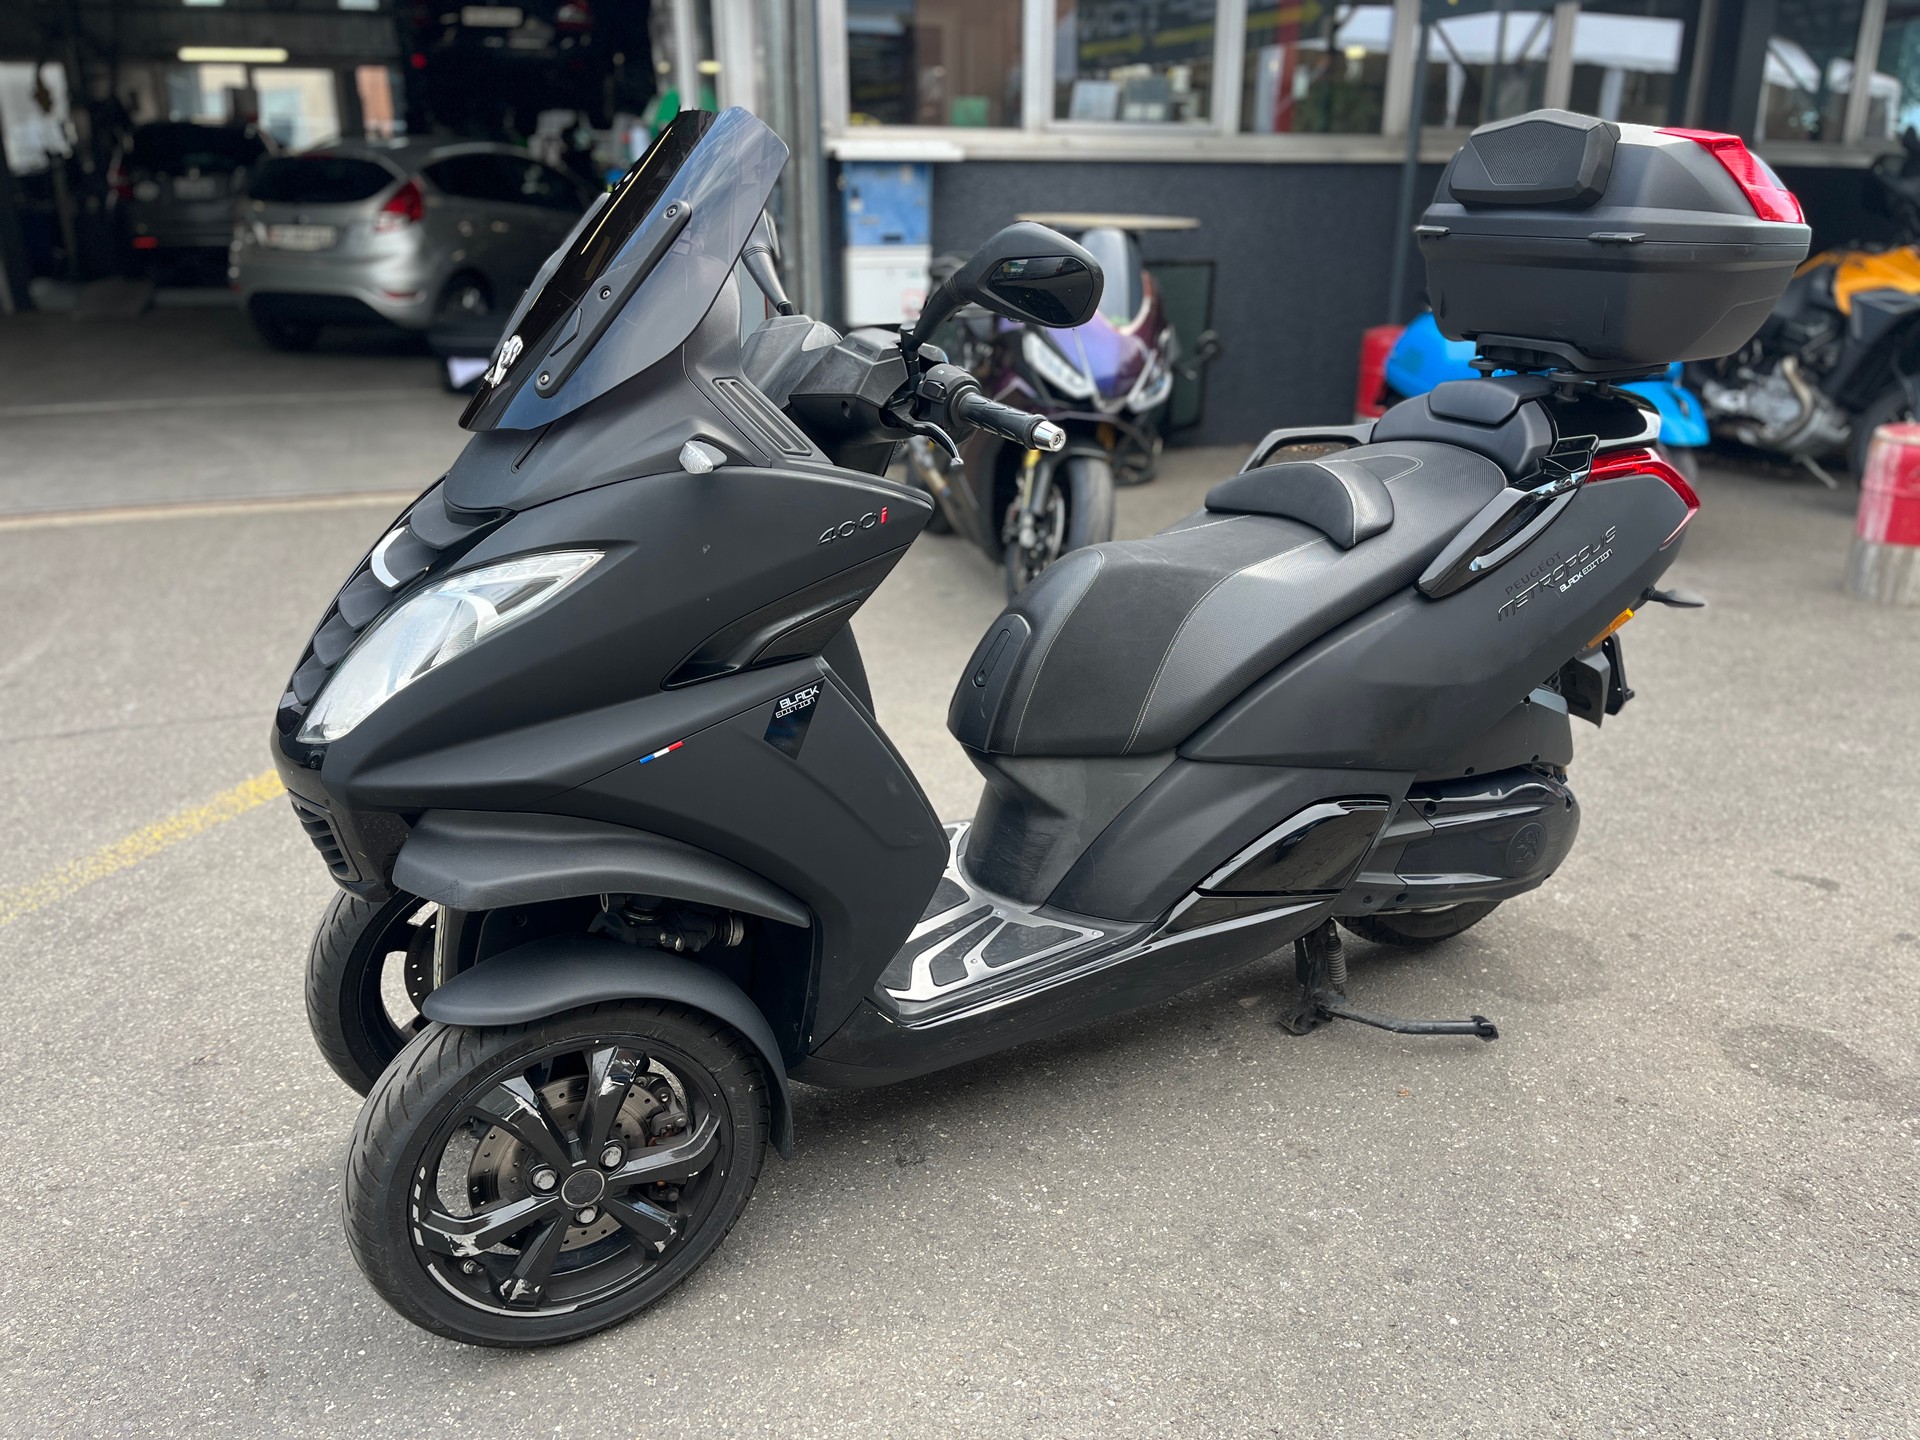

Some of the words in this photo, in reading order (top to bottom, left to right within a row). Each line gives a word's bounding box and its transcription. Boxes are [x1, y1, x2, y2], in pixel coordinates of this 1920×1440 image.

[817, 506, 888, 546] 400i
[1497, 525, 1617, 622] METROPOLIS
[1504, 551, 1562, 596] PEUGEOT
[1559, 571, 1584, 593] BLACK
[1581, 548, 1613, 576] EDITION
[775, 696, 816, 719] EDITION
[779, 685, 820, 709] BLACK
